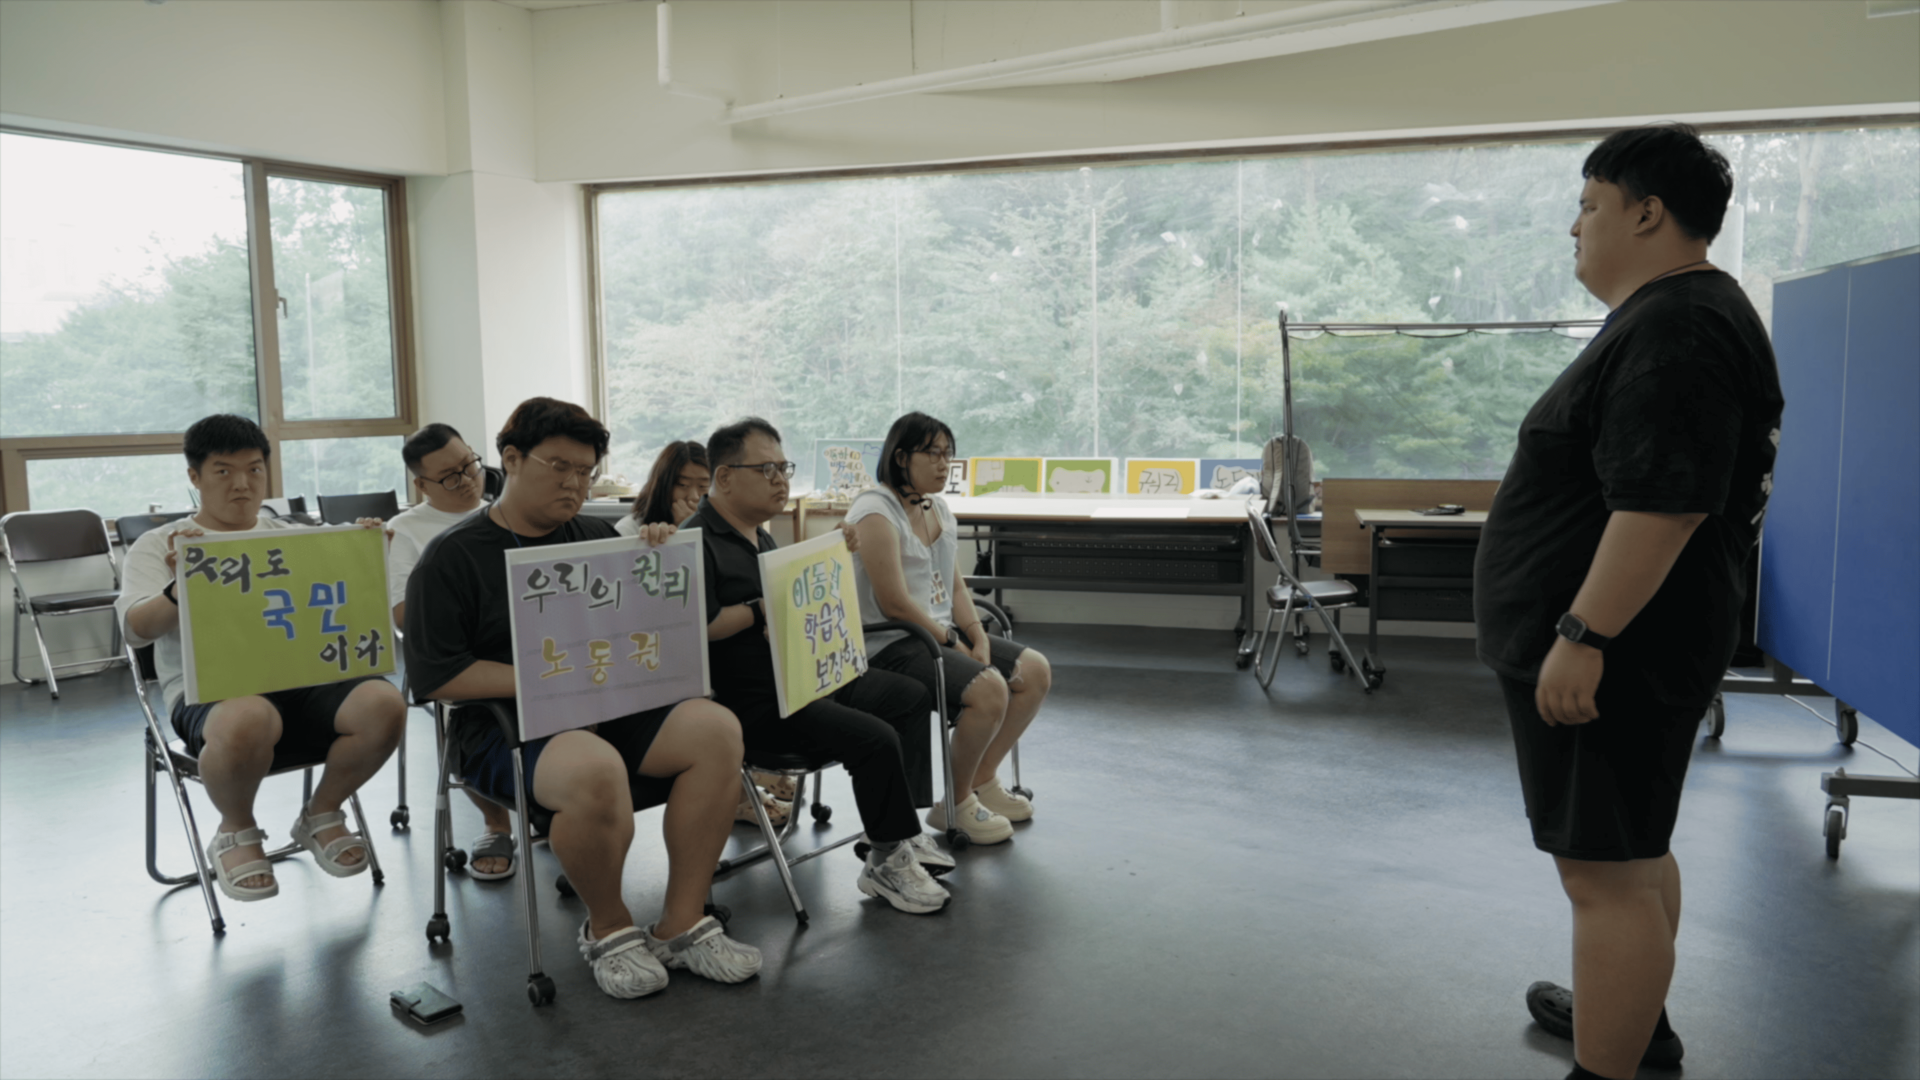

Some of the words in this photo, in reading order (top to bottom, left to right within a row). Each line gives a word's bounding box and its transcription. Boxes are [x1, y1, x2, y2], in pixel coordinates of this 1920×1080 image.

[262, 581, 346, 639] 국민
[522, 562, 621, 613] 우리의
[631, 551, 689, 609] 권리
[540, 632, 660, 684] 노동권
